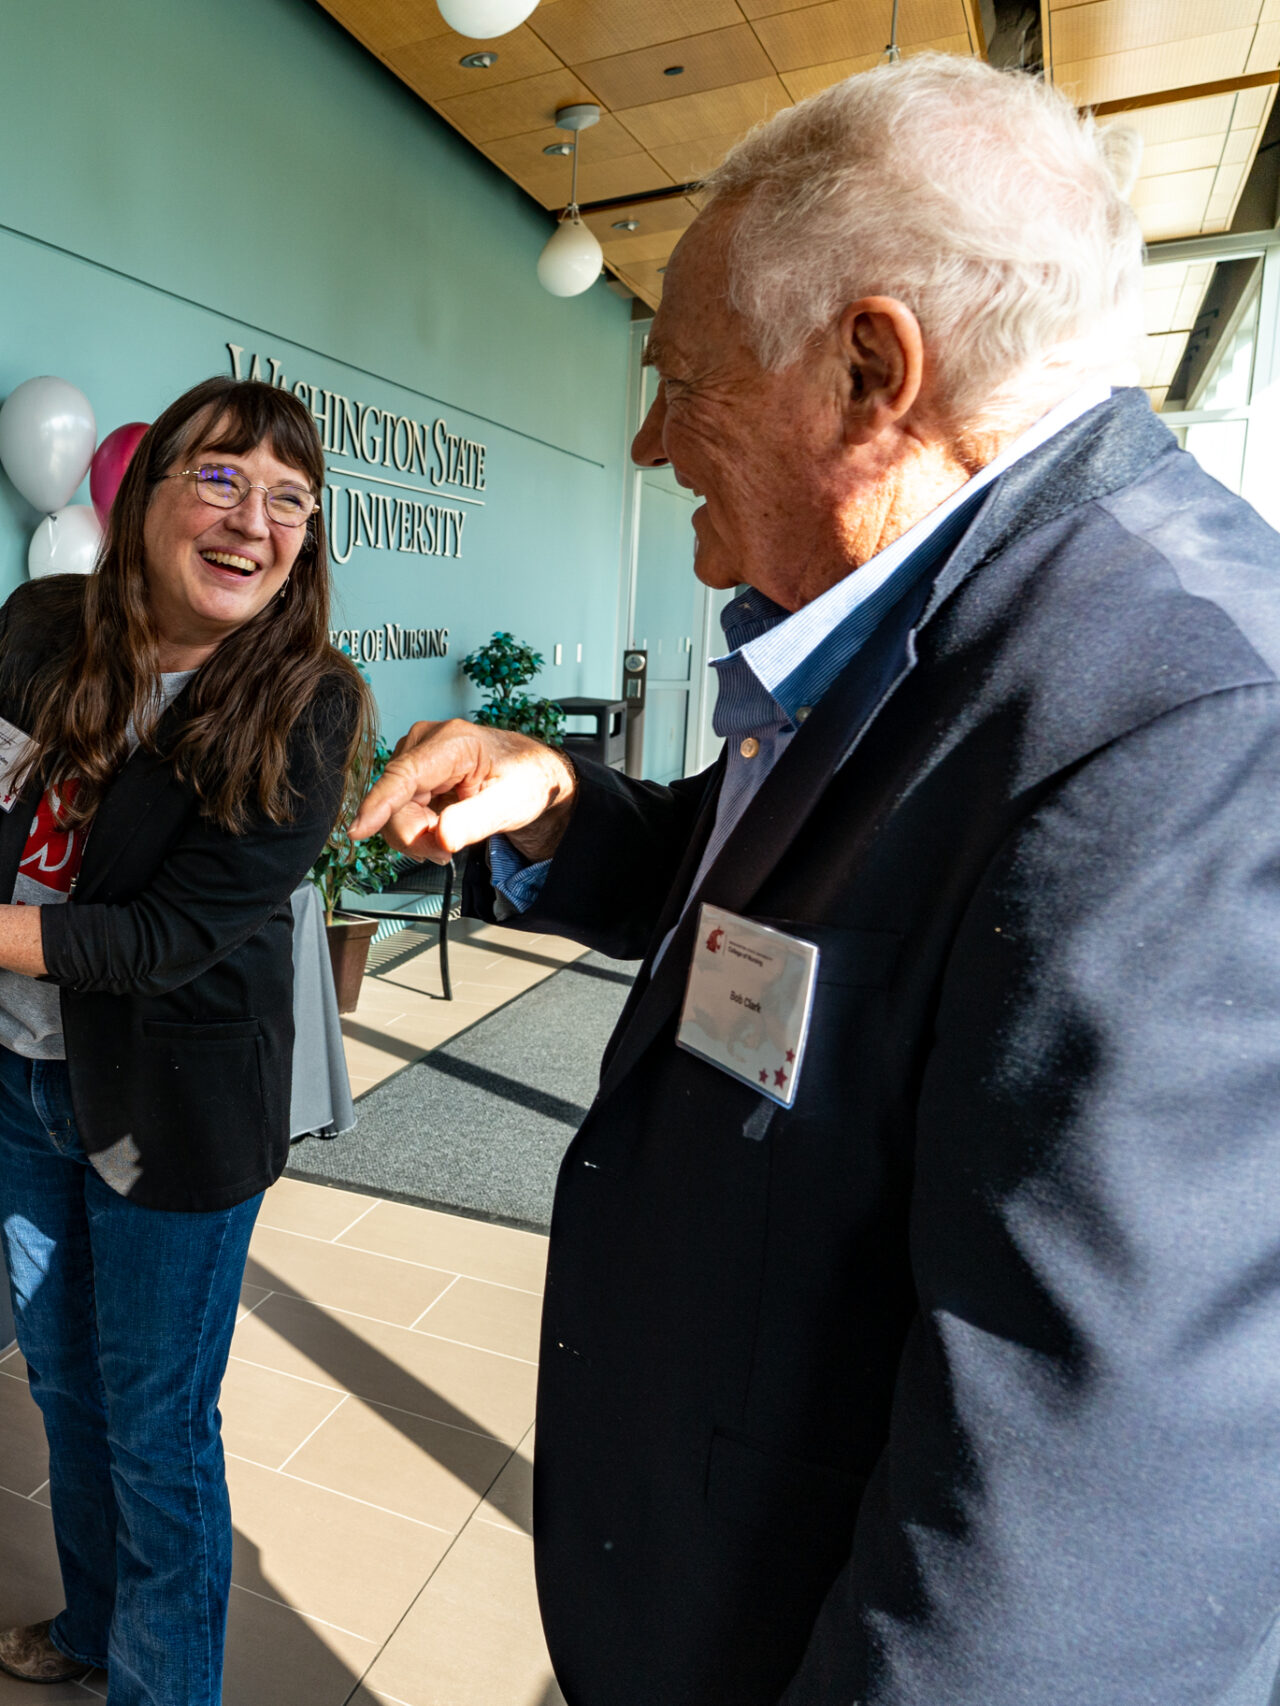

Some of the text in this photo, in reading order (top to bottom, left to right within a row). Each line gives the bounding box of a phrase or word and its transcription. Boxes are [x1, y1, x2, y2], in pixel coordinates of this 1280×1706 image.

[431, 418, 487, 491] STATE
[327, 484, 467, 564] UNIVERSITY
[361, 629, 384, 662] OF
[383, 623, 450, 661] NURSING
